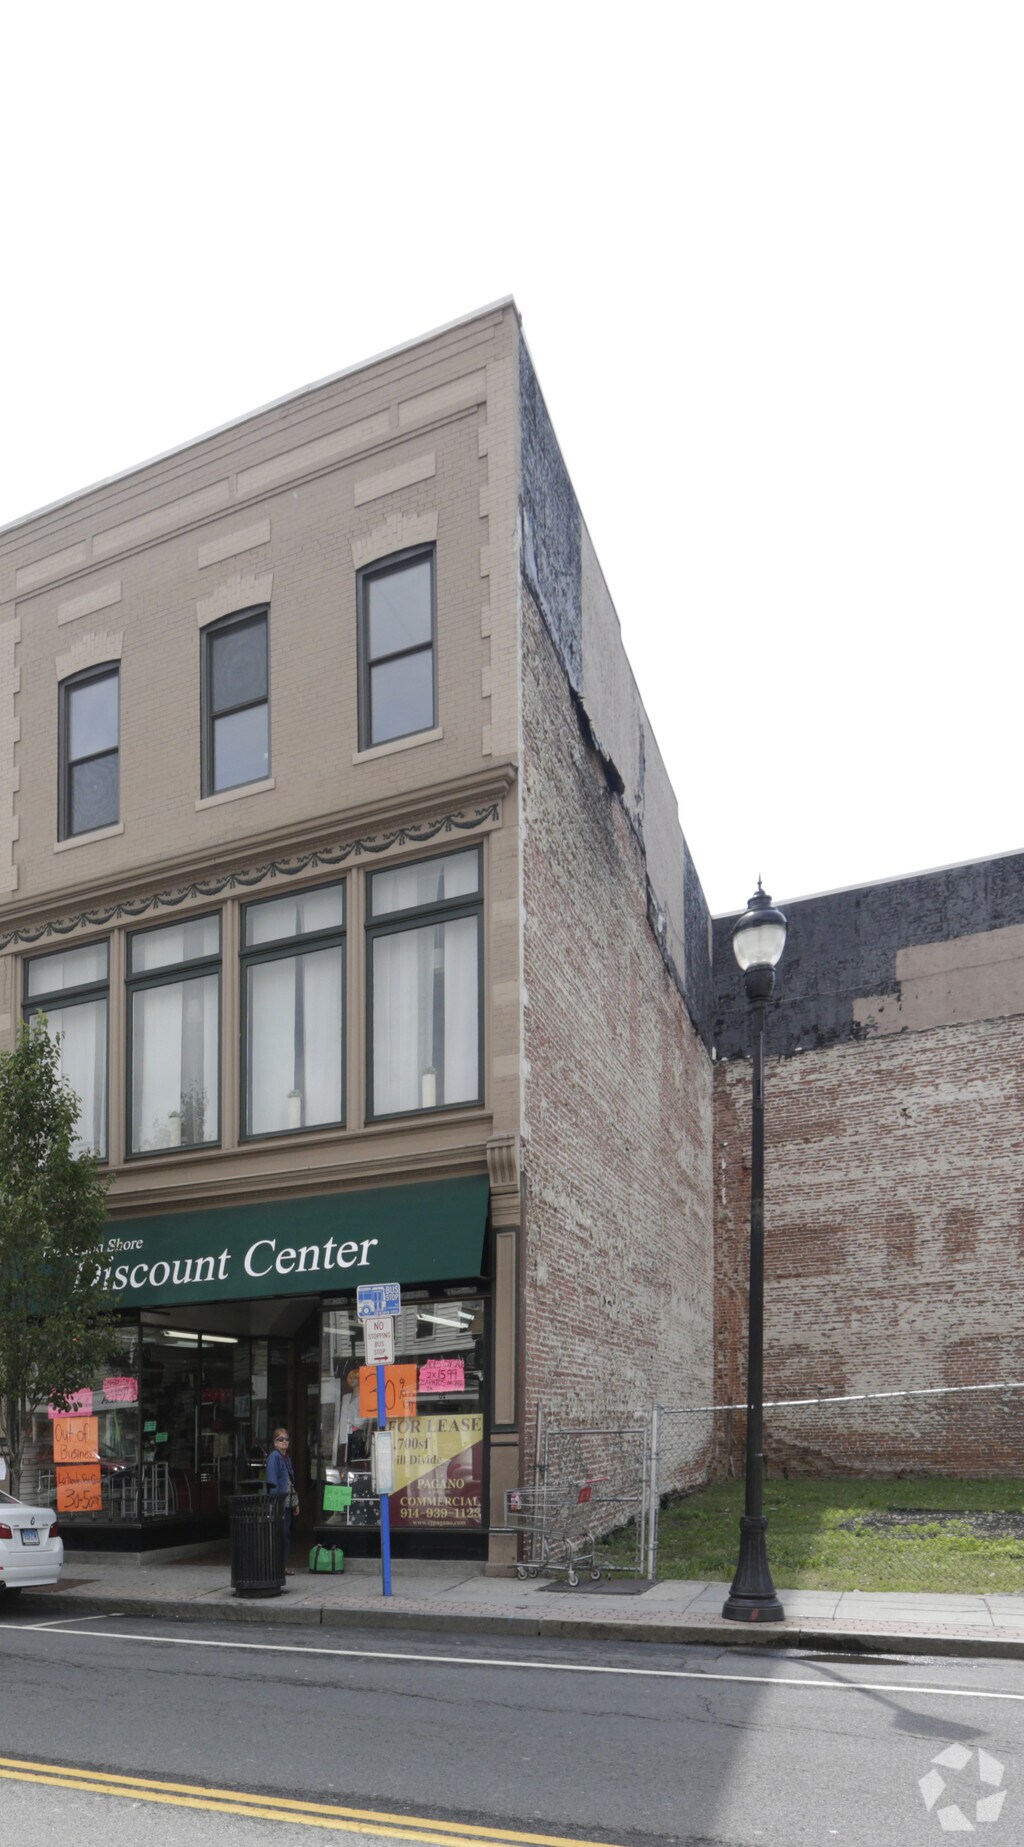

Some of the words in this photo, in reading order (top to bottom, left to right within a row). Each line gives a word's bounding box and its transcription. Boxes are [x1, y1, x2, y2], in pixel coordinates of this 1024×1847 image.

[107, 1238, 144, 1253] Shore
[244, 1236, 379, 1278] Center
[385, 1285, 399, 1293] BUS
[373, 1322, 384, 1331] NO
[388, 1419, 421, 1434] FOR
[427, 1417, 481, 1433] LEASE
[54, 1424, 72, 1442] Out
[77, 1422, 89, 1442] of
[396, 1455, 406, 1465] ill
[409, 1455, 442, 1465] Divide
[417, 1478, 465, 1489] PAGANO
[400, 1496, 480, 1507] COMMERCIAL
